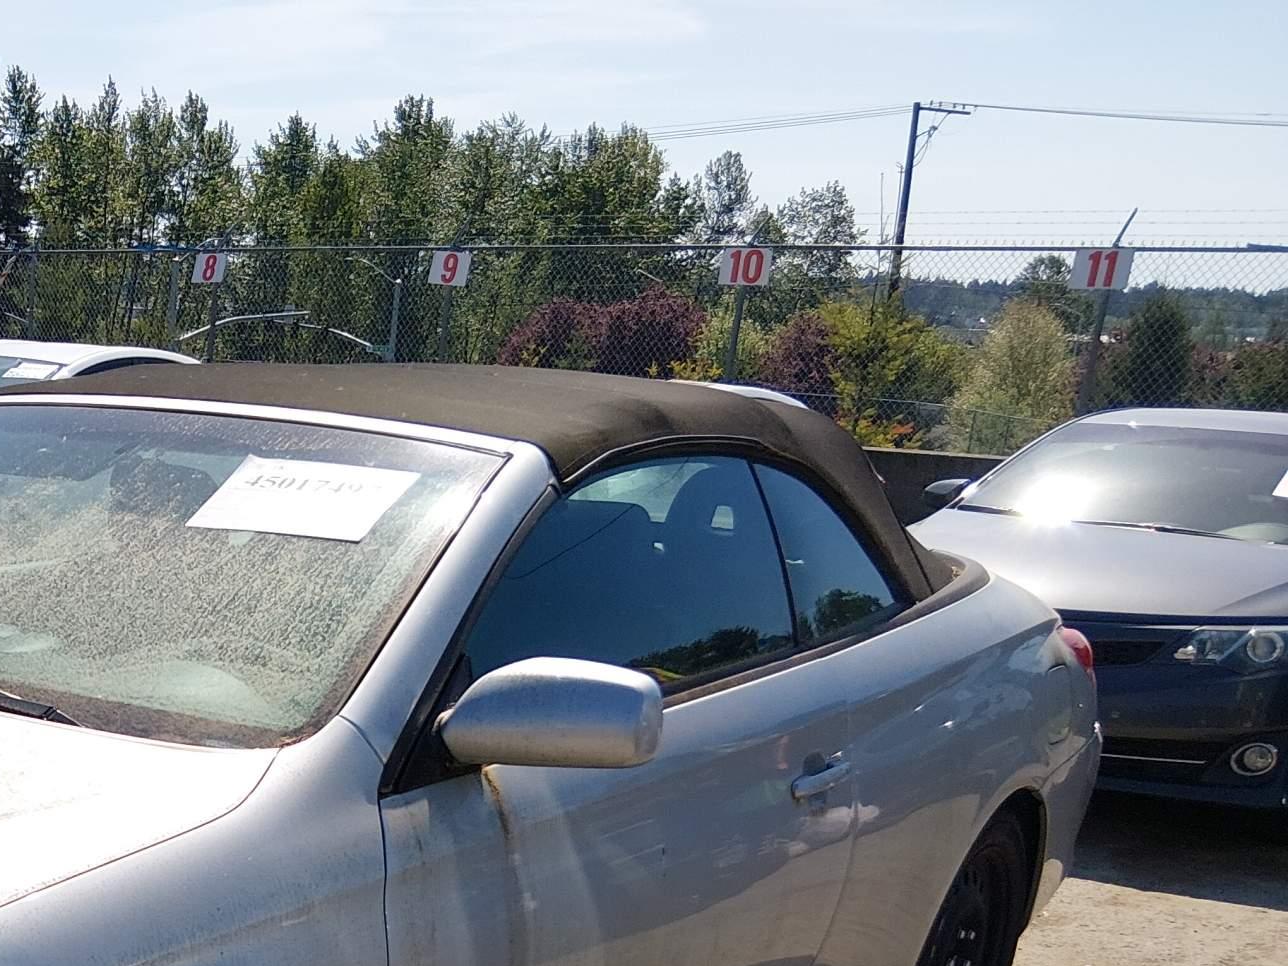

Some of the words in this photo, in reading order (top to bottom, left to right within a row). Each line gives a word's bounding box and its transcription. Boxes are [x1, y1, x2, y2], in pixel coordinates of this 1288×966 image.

[202, 254, 218, 282] 8
[440, 253, 459, 284] 9
[729, 249, 764, 284] 10
[1086, 250, 1120, 288] 11
[244, 474, 386, 494] 4501749
